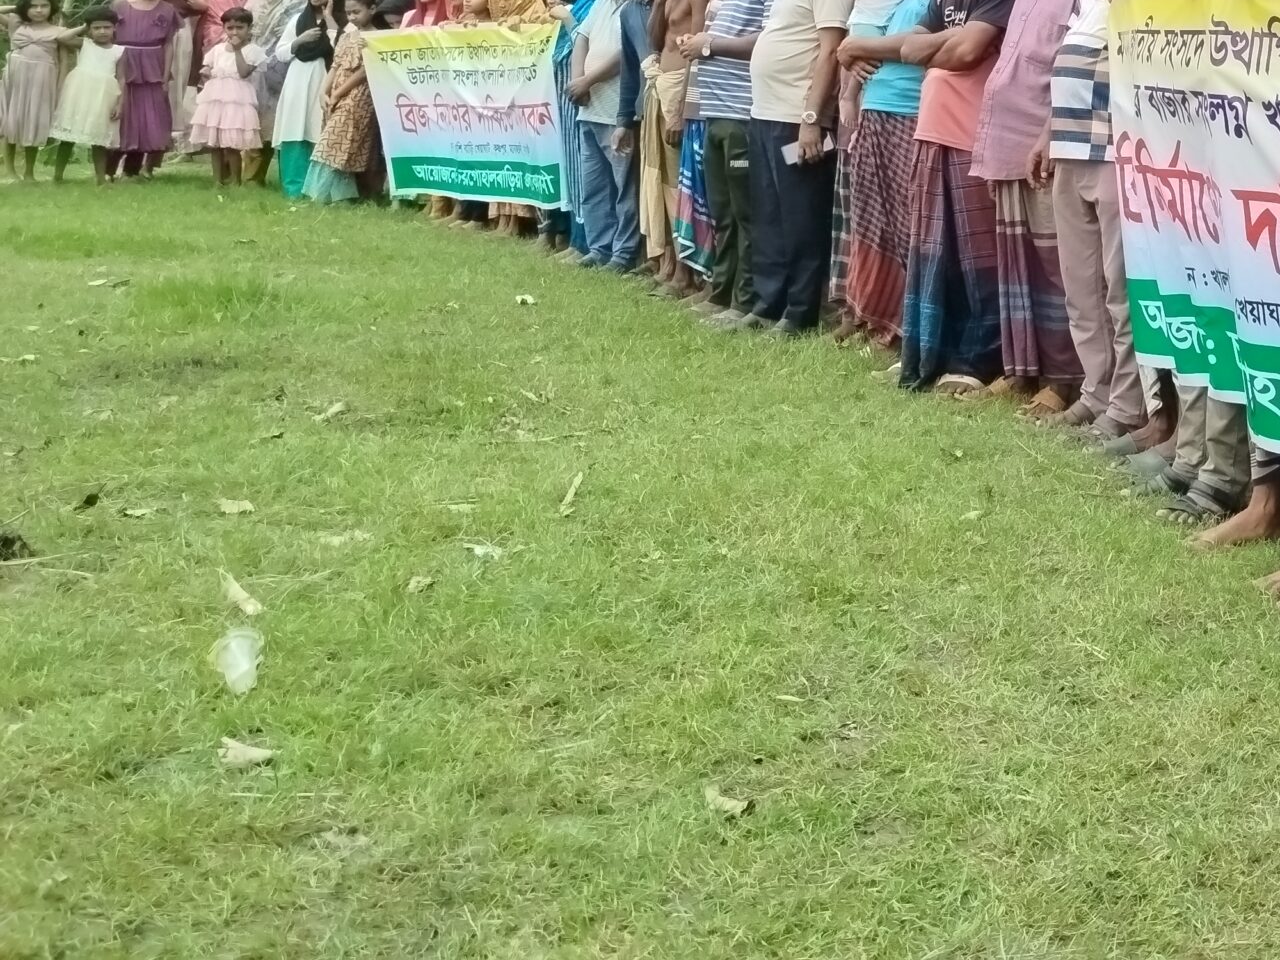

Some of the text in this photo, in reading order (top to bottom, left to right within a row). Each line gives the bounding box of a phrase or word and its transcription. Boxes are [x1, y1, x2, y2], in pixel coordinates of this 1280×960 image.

[377, 48, 413, 65] মহান
[1160, 29, 1206, 72] সংসদে
[1143, 82, 1194, 126] বাজার
[1189, 89, 1254, 146] সংলগ্ন
